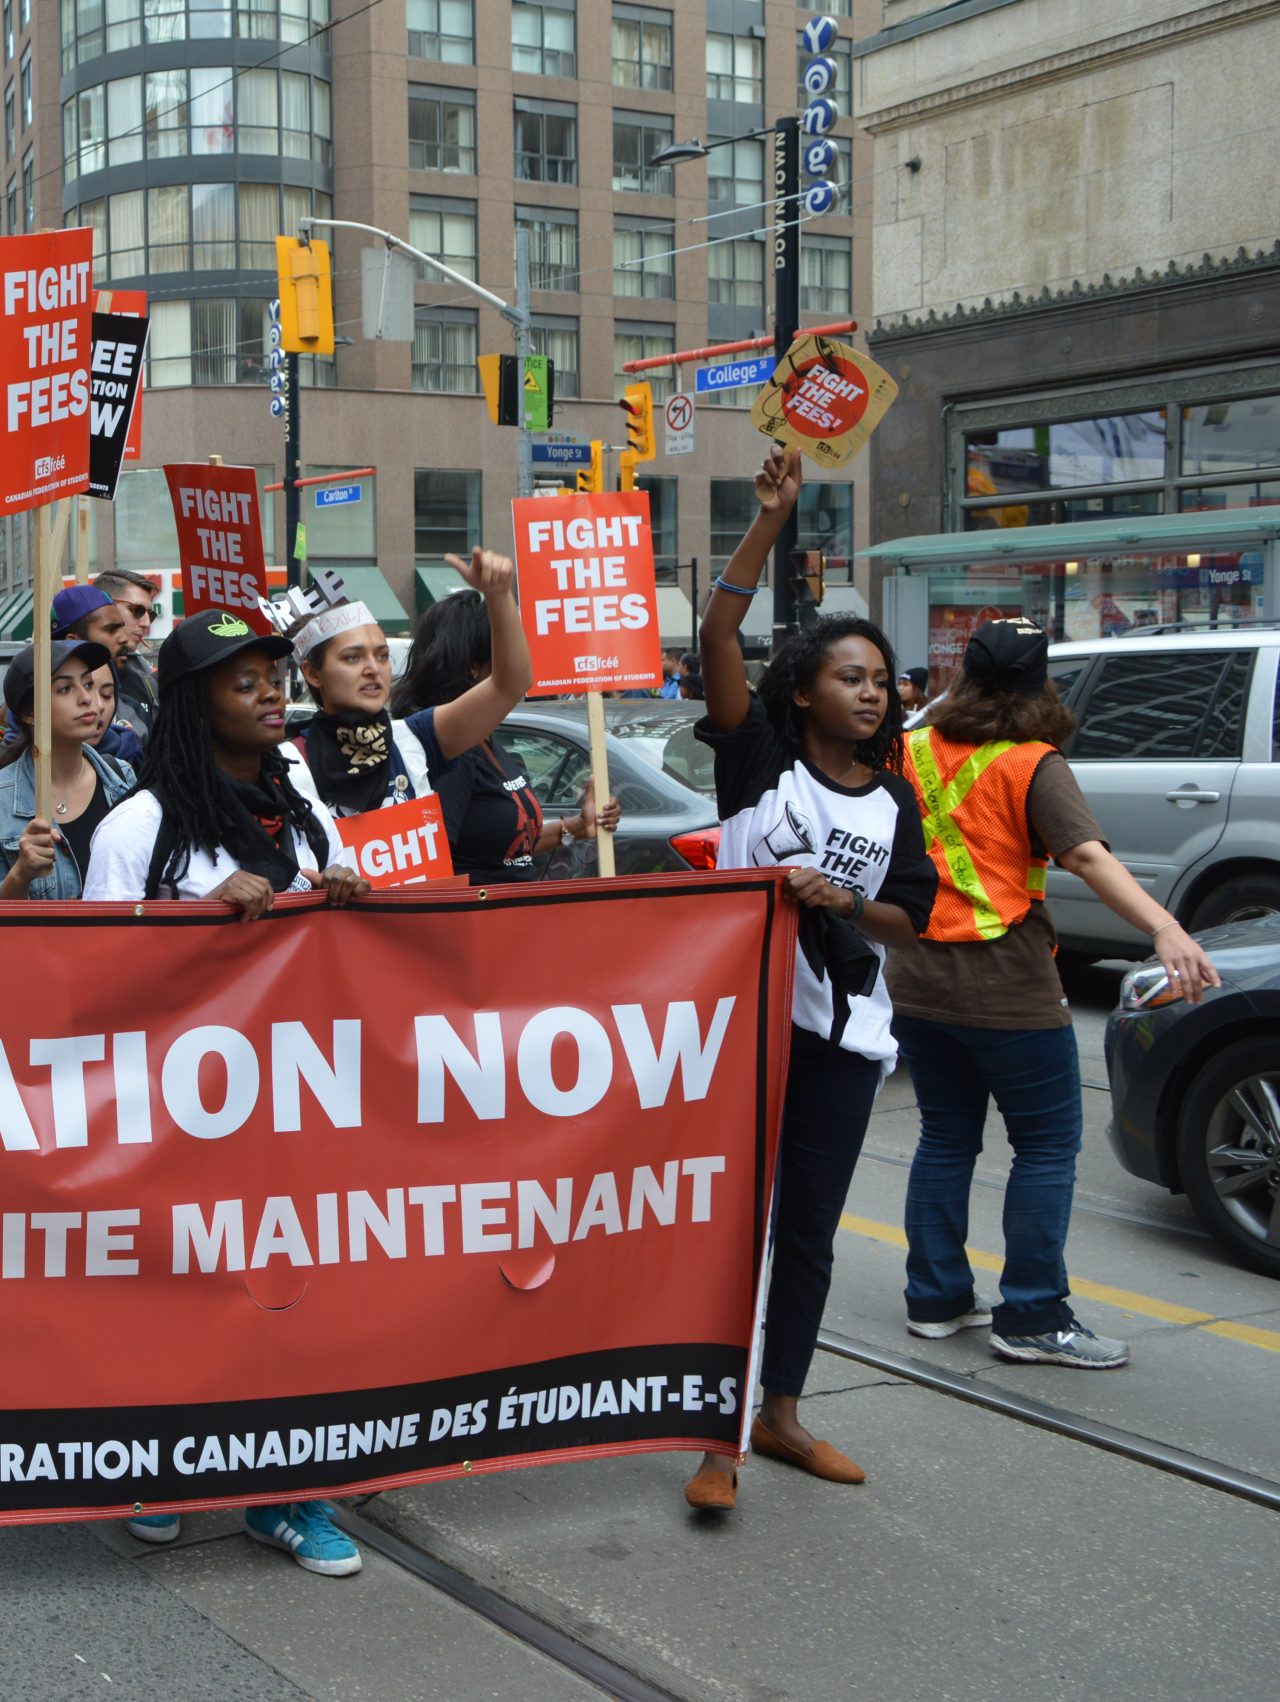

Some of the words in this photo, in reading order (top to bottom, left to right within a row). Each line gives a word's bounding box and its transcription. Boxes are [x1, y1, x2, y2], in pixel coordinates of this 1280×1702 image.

[804, 16, 831, 215] Yonge
[775, 131, 786, 269] DOWNTOWN
[4, 261, 90, 316] FIGHT
[23, 318, 78, 369] THE
[91, 339, 137, 377] EE
[524, 359, 543, 369] TICE
[707, 363, 757, 386] College
[759, 360, 768, 369] St
[807, 364, 864, 402] FIGHT
[7, 368, 88, 432] FEES
[798, 379, 837, 408] THE
[786, 394, 843, 432] FEES!
[547, 446, 574, 460] Yonge
[575, 450, 582, 458] St
[5, 489, 32, 503] CANADIAN
[32, 481, 60, 496] FEDERATION
[179, 487, 251, 525] FIGHT
[323, 490, 349, 503] Carlton
[197, 528, 243, 565] THE
[528, 516, 642, 552] FIGHT
[190, 565, 261, 610] FEES
[550, 556, 627, 591] THE
[1208, 569, 1240, 584] Yonge
[535, 593, 649, 635] FEES
[538, 678, 572, 687] CANADIAN
[573, 676, 612, 685] FEDERATION
[624, 673, 655, 681] STUDENTS
[342, 823, 439, 879] IGHT
[820, 850, 868, 878] THE
[826, 828, 889, 867] FIGHT
[414, 996, 737, 1124] NOW
[171, 1156, 725, 1275] MAINTENANT
[172, 1414, 420, 1475] CANADIENNE
[429, 1399, 487, 1440] DES
[498, 1374, 737, 1431] ÉTUDIANT-E-S
